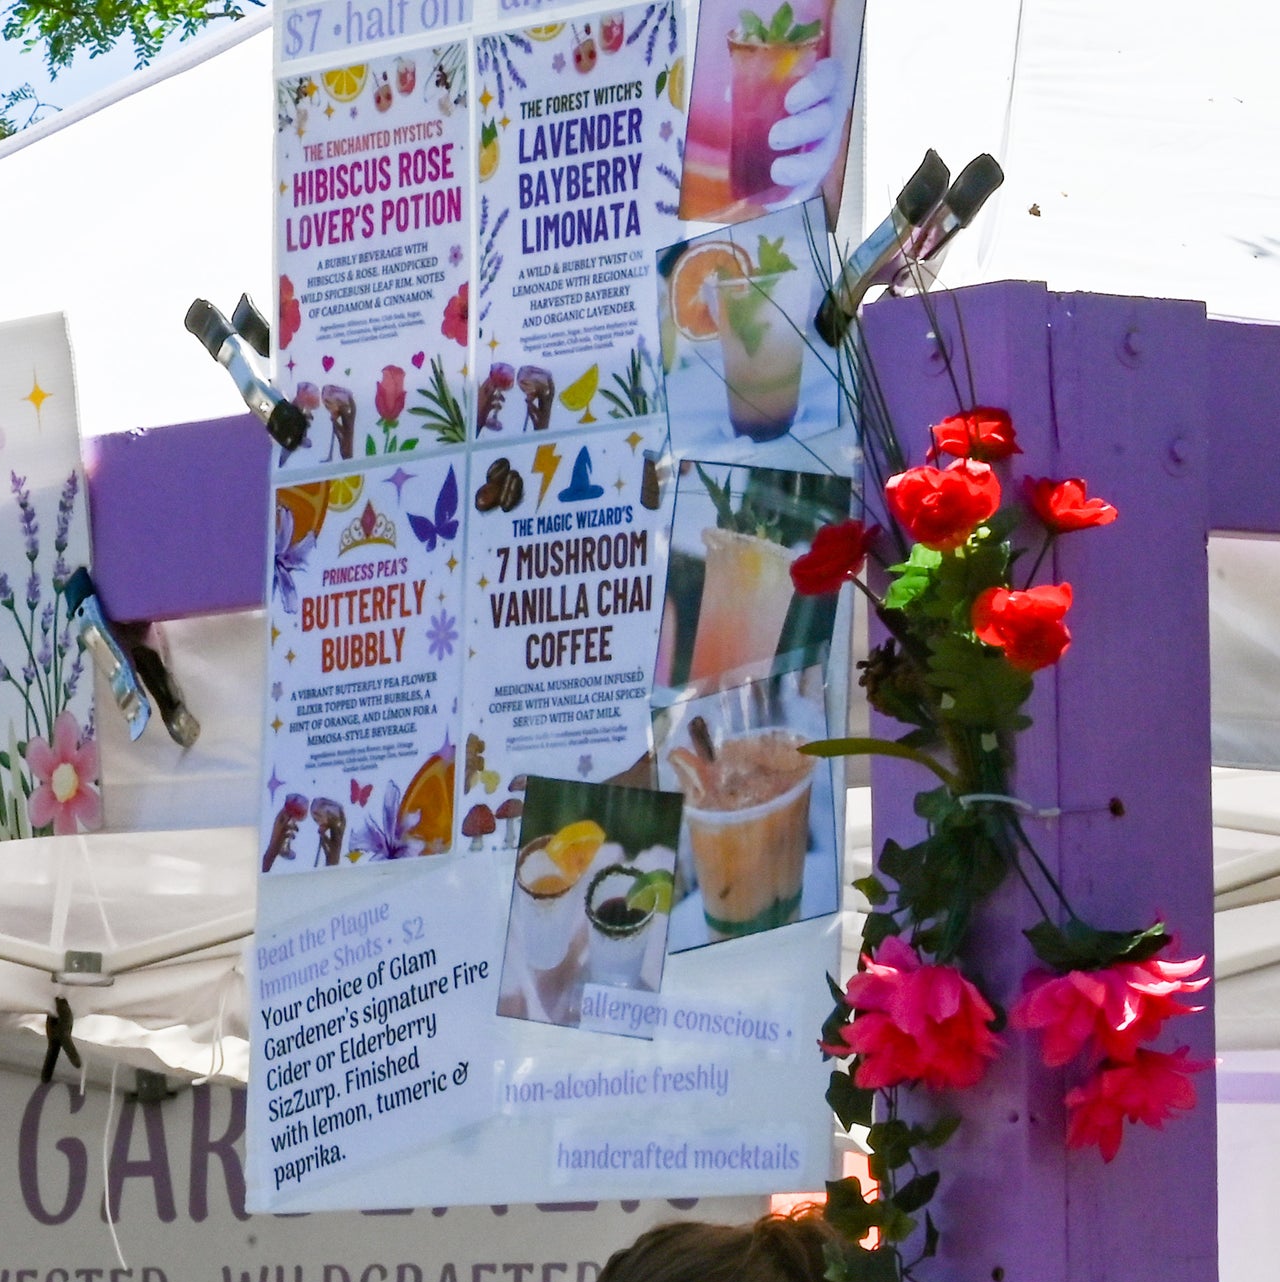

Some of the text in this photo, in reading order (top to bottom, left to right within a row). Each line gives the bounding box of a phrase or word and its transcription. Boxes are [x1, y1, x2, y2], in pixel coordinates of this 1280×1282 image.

[285, 8, 322, 56] $7
[520, 100, 542, 119] THE
[547, 91, 589, 115] FOREST
[304, 120, 443, 162] THE ENCHANTED MYSTIC'S
[519, 108, 642, 164] LAVENDER
[294, 143, 454, 207] HIBISCUS ROSE
[519, 153, 642, 209] BAYBERRY
[287, 186, 461, 251] LOVER'S POTION
[522, 200, 640, 254] LIMONATA
[307, 272, 346, 288] HIBISCUS
[347, 271, 354, 281] &
[382, 257, 438, 276] HANDPICKED
[325, 242, 428, 268] BUBBLY BEVERAGE WITH
[526, 250, 643, 278] WILD & BUBBLY TWIST ON
[301, 291, 322, 304] WILD
[325, 284, 370, 301] SPICEBUSH
[373, 280, 393, 292] LEAF
[416, 272, 445, 285] NOTES
[512, 265, 650, 297] LEMONADE WITH REGIONALLY
[530, 285, 631, 311] HARVESTED BAYBERRY
[308, 308, 320, 319] OF
[322, 300, 372, 318] CARDAMOM
[374, 298, 381, 308] &
[522, 316, 542, 329] AND
[544, 309, 585, 325] ORGANIC
[512, 505, 633, 537] THE MAGIC WIZARD'S
[322, 563, 374, 587] PRINCESS
[497, 530, 648, 583] 7 MUSHROOM
[302, 579, 426, 632] BUTTERFLY
[490, 575, 652, 629] VANILLA CHAI
[322, 627, 405, 673] BUBBLY
[526, 625, 613, 670] COFFEE
[298, 672, 437, 700] VIBRANT BUTTERFLY PEA FLOWER
[489, 701, 522, 714] COFFEE
[525, 698, 549, 709] WITH
[552, 694, 590, 707] VANILLA
[591, 691, 614, 703] CHAI
[494, 671, 644, 697] MEDICINAL MUSHROOM INFUSED
[289, 721, 310, 733] HINT
[311, 719, 322, 730] OF
[362, 711, 381, 723] AND
[413, 705, 429, 717] FOR
[297, 703, 323, 716] ELIXIR
[325, 699, 357, 713] TOPPED
[359, 695, 382, 707] WITH
[512, 714, 548, 728] SERVED
[550, 711, 574, 723] WITH
[576, 709, 594, 721] OAT
[307, 729, 370, 746] MIMOSA-STYLE
[257, 903, 390, 970] Beat the Plague
[260, 916, 425, 1000] Immune Shots $2
[262, 949, 437, 1030] Your choice of Glam
[264, 960, 489, 1060] Gardener's signature Fire
[582, 992, 779, 1041] allergen conscious
[267, 1013, 437, 1091] Cider or Elderberry
[269, 1046, 420, 1122] SizZurp. Finished
[505, 1064, 729, 1102] non-alcoholic freshly
[271, 1061, 469, 1153] with lemon, tumeric &
[273, 1144, 346, 1190] paprika.
[557, 1142, 800, 1170] handcrafted mocktails
